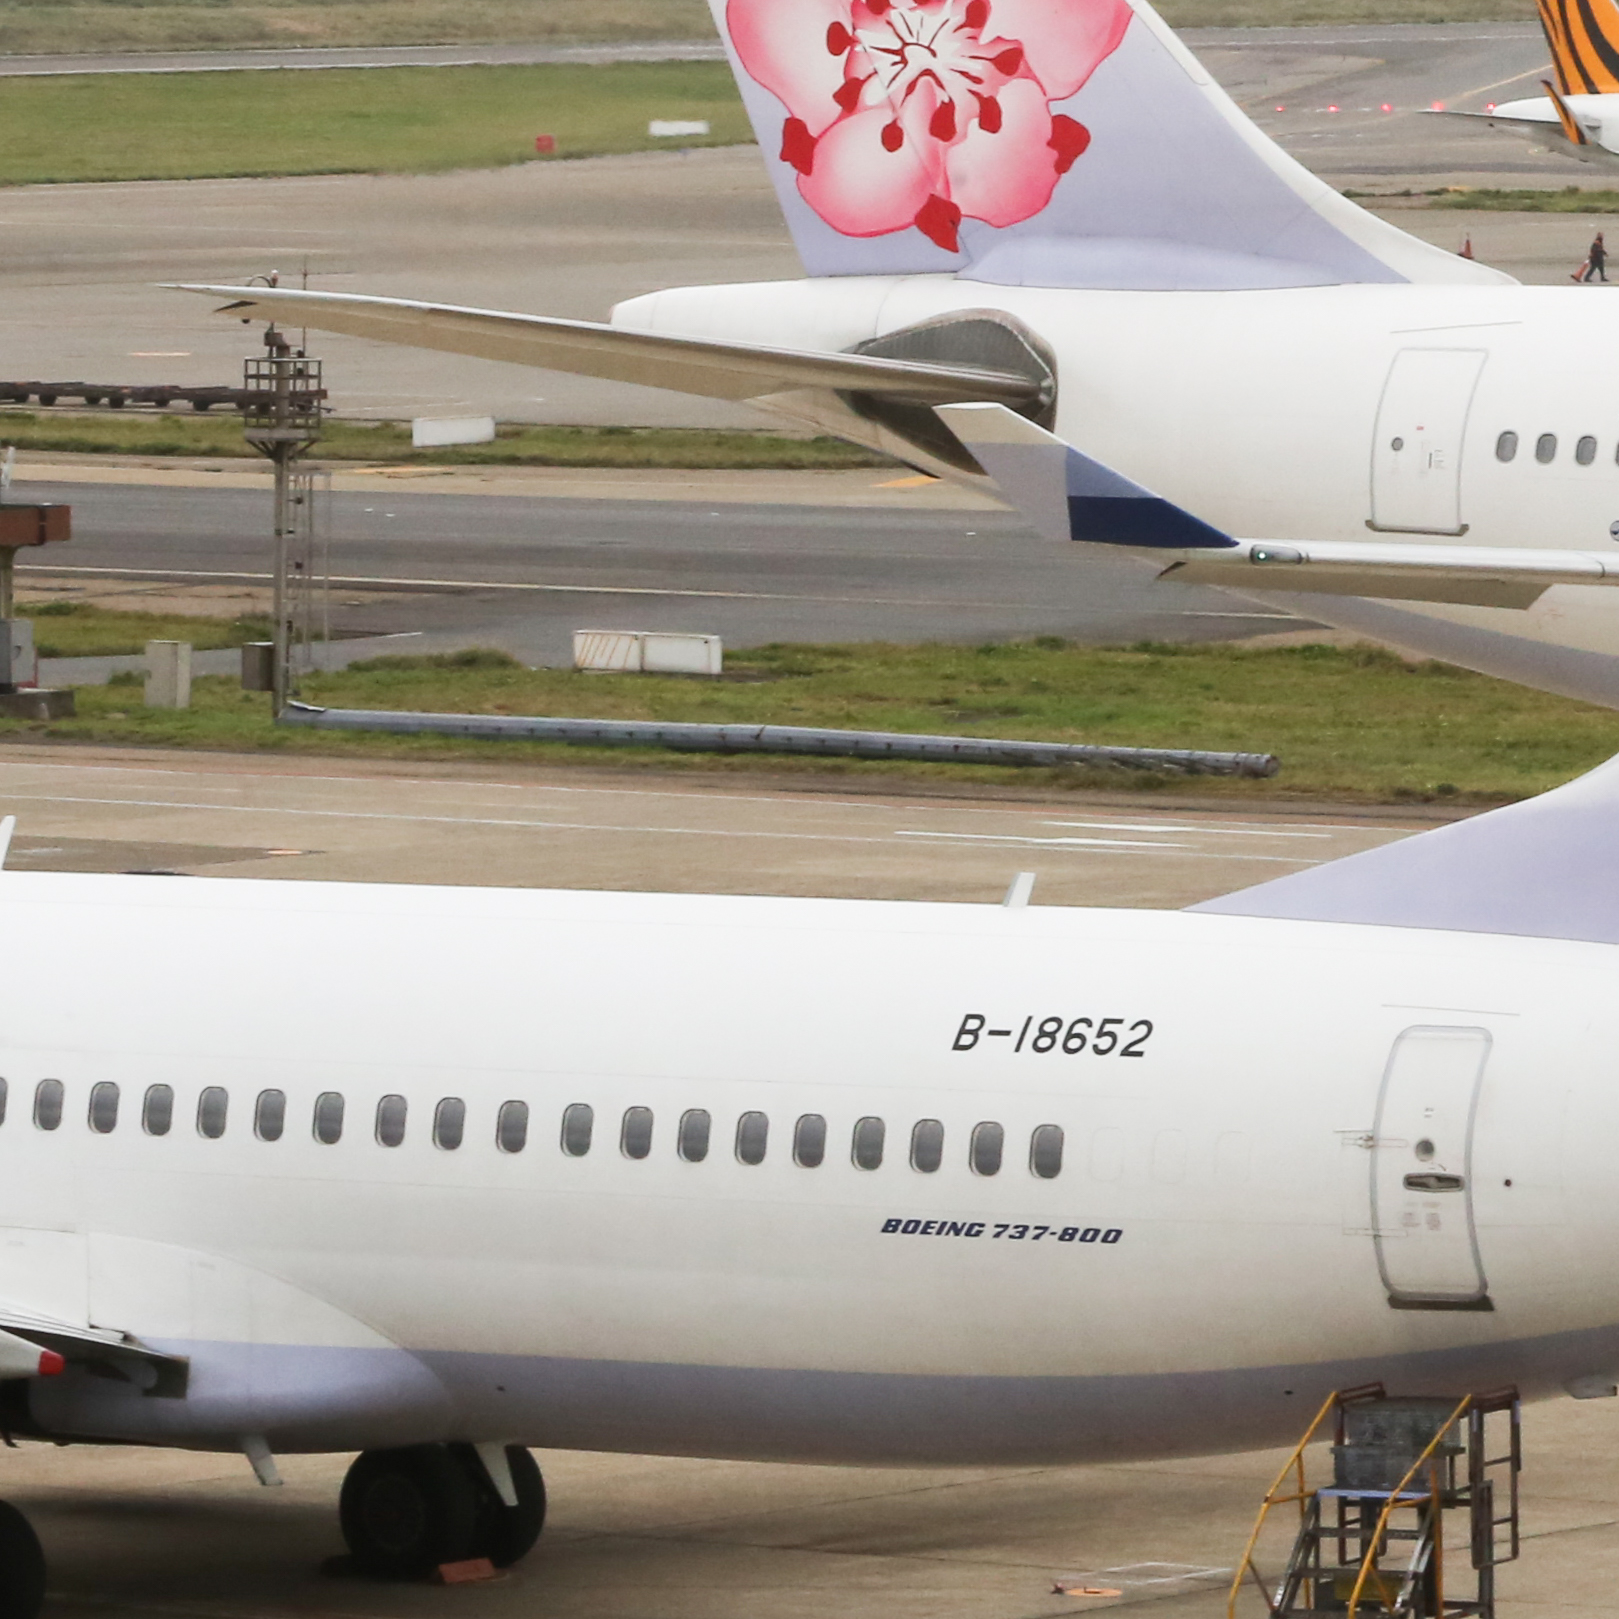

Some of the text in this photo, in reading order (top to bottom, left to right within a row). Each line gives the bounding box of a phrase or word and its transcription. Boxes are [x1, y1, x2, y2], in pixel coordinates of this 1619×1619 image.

[951, 1013, 1154, 1058] B-18652
[881, 1218, 1123, 1244] BOEING 737-800
